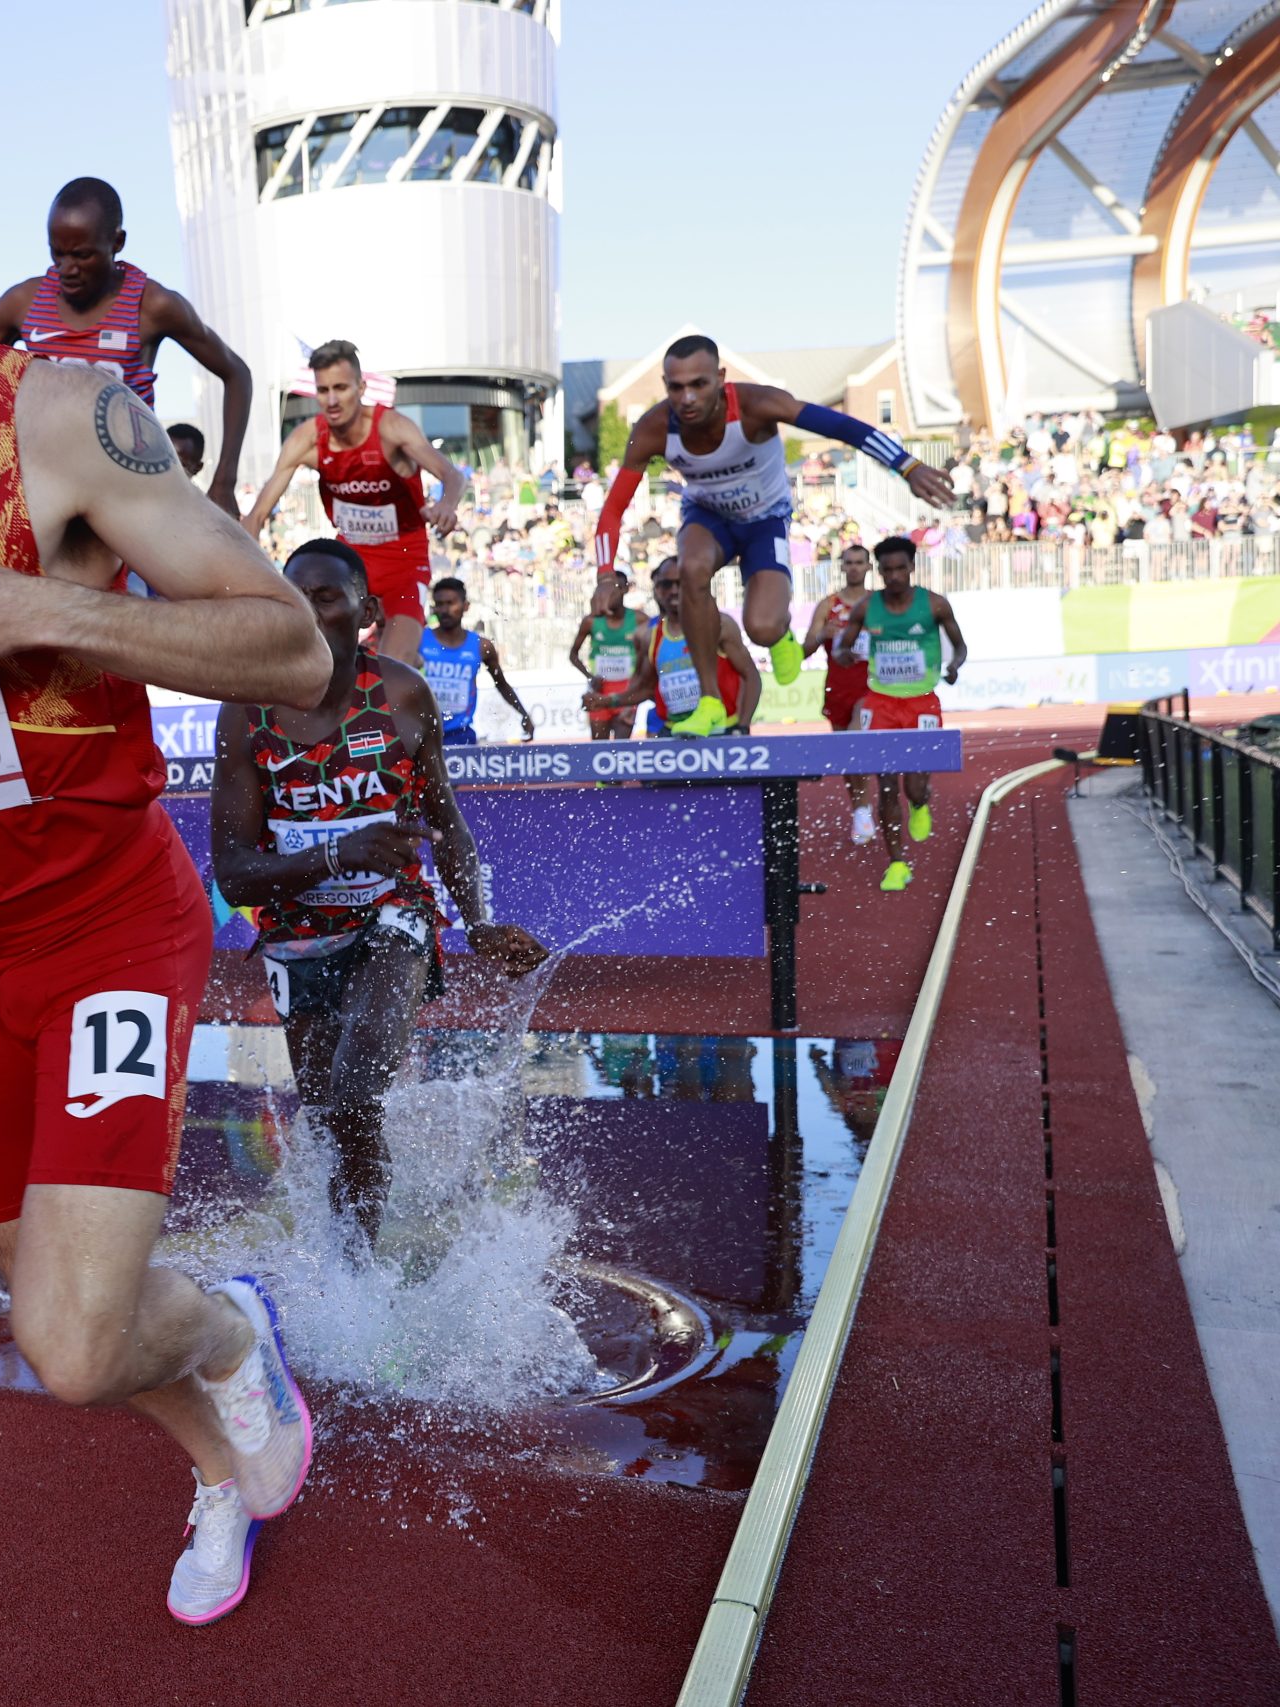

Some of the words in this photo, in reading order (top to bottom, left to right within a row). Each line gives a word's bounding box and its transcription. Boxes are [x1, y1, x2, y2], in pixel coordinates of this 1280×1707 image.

[351, 508, 384, 519] TDK
[348, 520, 394, 533] BAKKALI
[879, 666, 919, 677] AMARE
[1108, 666, 1171, 690] INEOS
[1199, 648, 1280, 689] xfini
[273, 770, 388, 811] KENYA
[84, 1009, 155, 1078] 12
